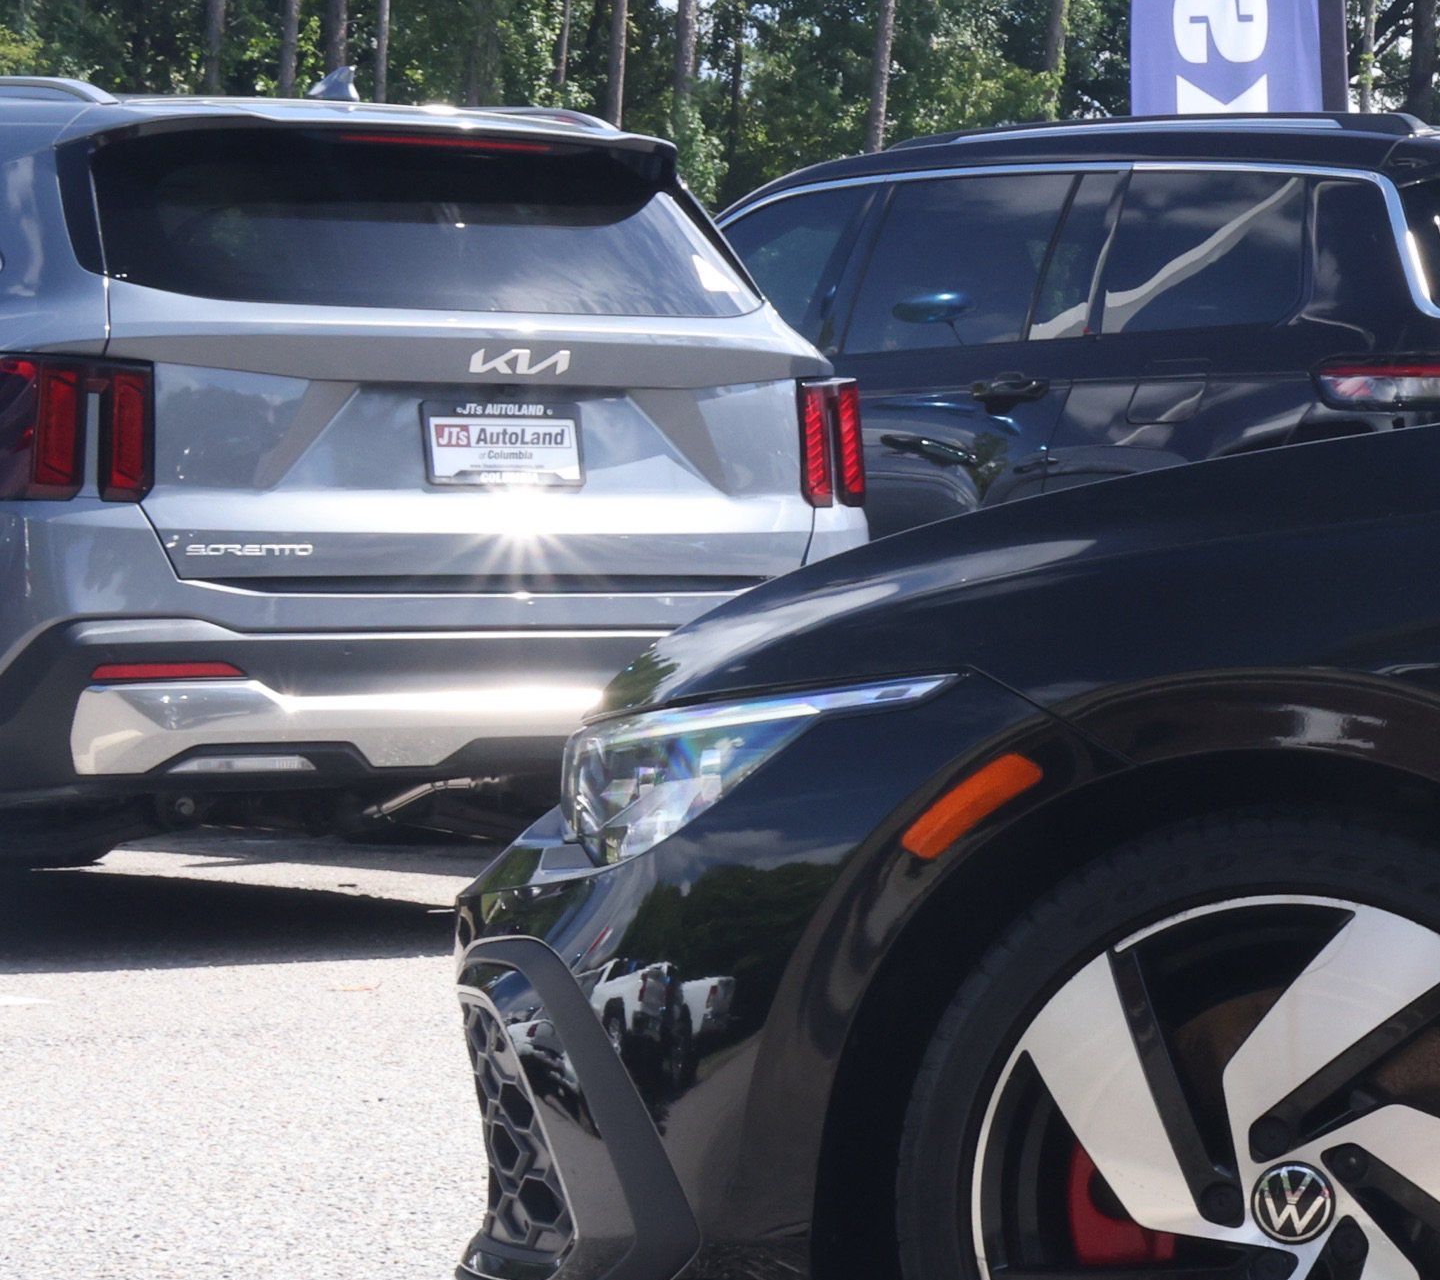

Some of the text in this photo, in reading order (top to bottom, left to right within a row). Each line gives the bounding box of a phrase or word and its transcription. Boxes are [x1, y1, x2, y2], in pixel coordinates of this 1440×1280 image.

[469, 348, 571, 375] KIA
[462, 403, 544, 415] JTs AUTOLAND
[438, 427, 565, 445] JTs AutoLand
[487, 450, 533, 460] Columbia
[186, 544, 313, 555] SORENTO
[1257, 1166, 1329, 1238] VW
